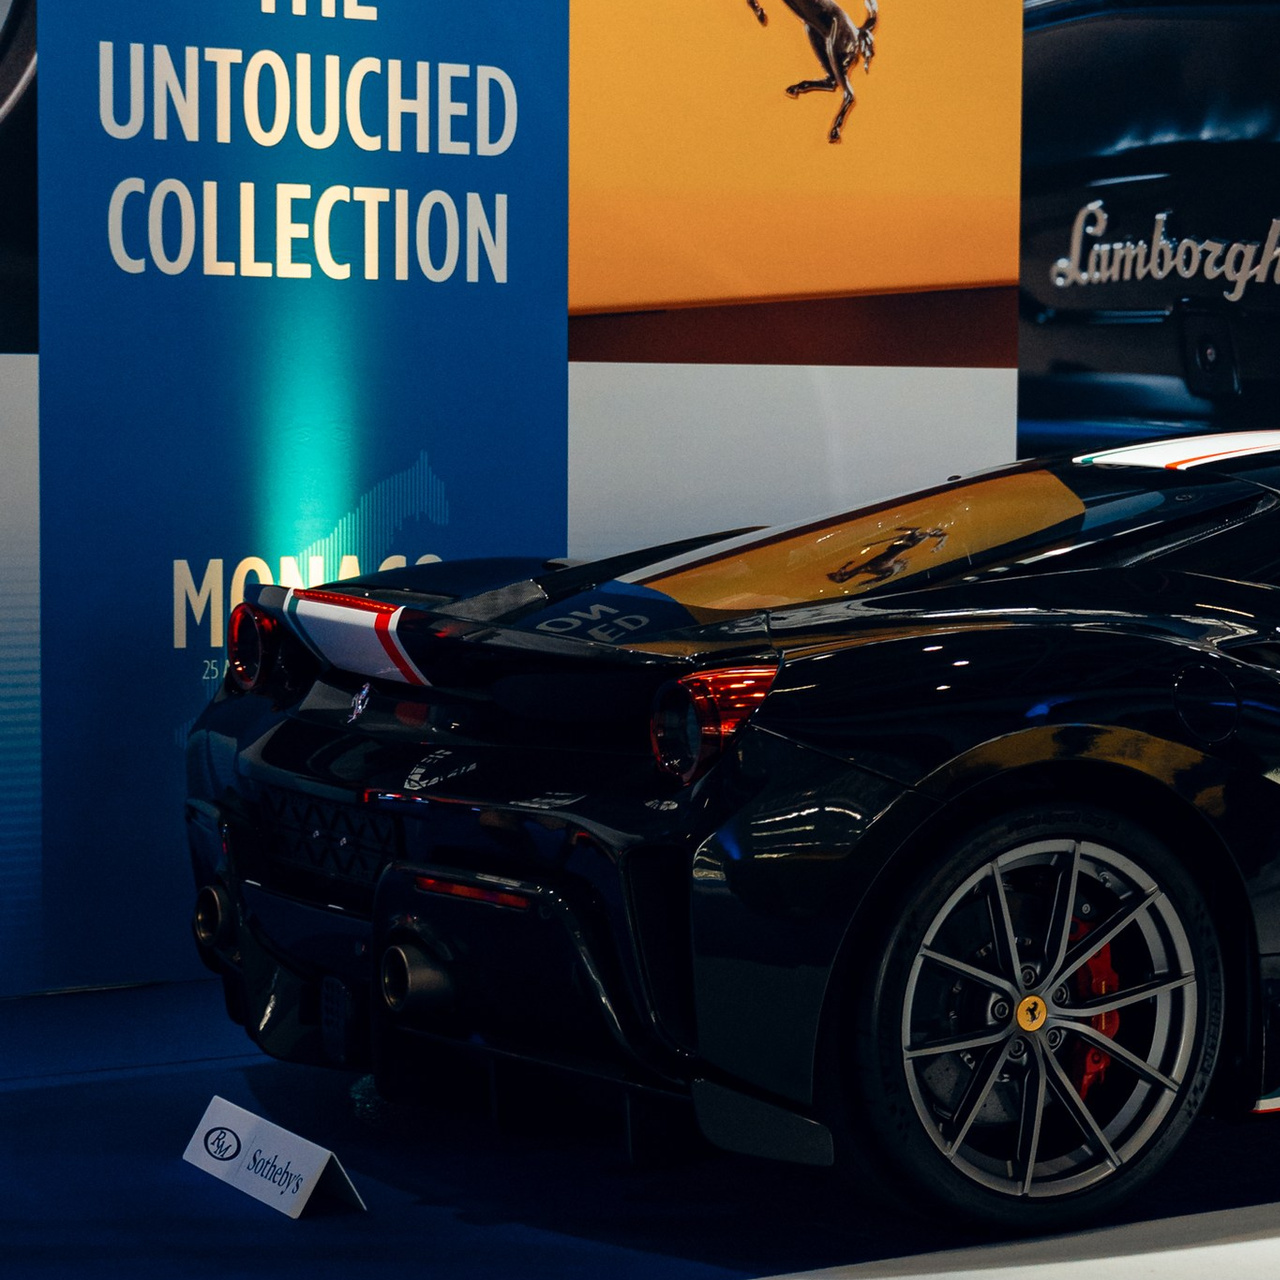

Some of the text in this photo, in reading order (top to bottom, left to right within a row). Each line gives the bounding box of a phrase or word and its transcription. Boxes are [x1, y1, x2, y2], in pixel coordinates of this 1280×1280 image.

[98, 40, 518, 157] UNTOUCHED
[107, 177, 508, 284] COLLECTION
[202, 659, 219, 680] 25
[210, 1130, 304, 1195] RM Sotheby's
